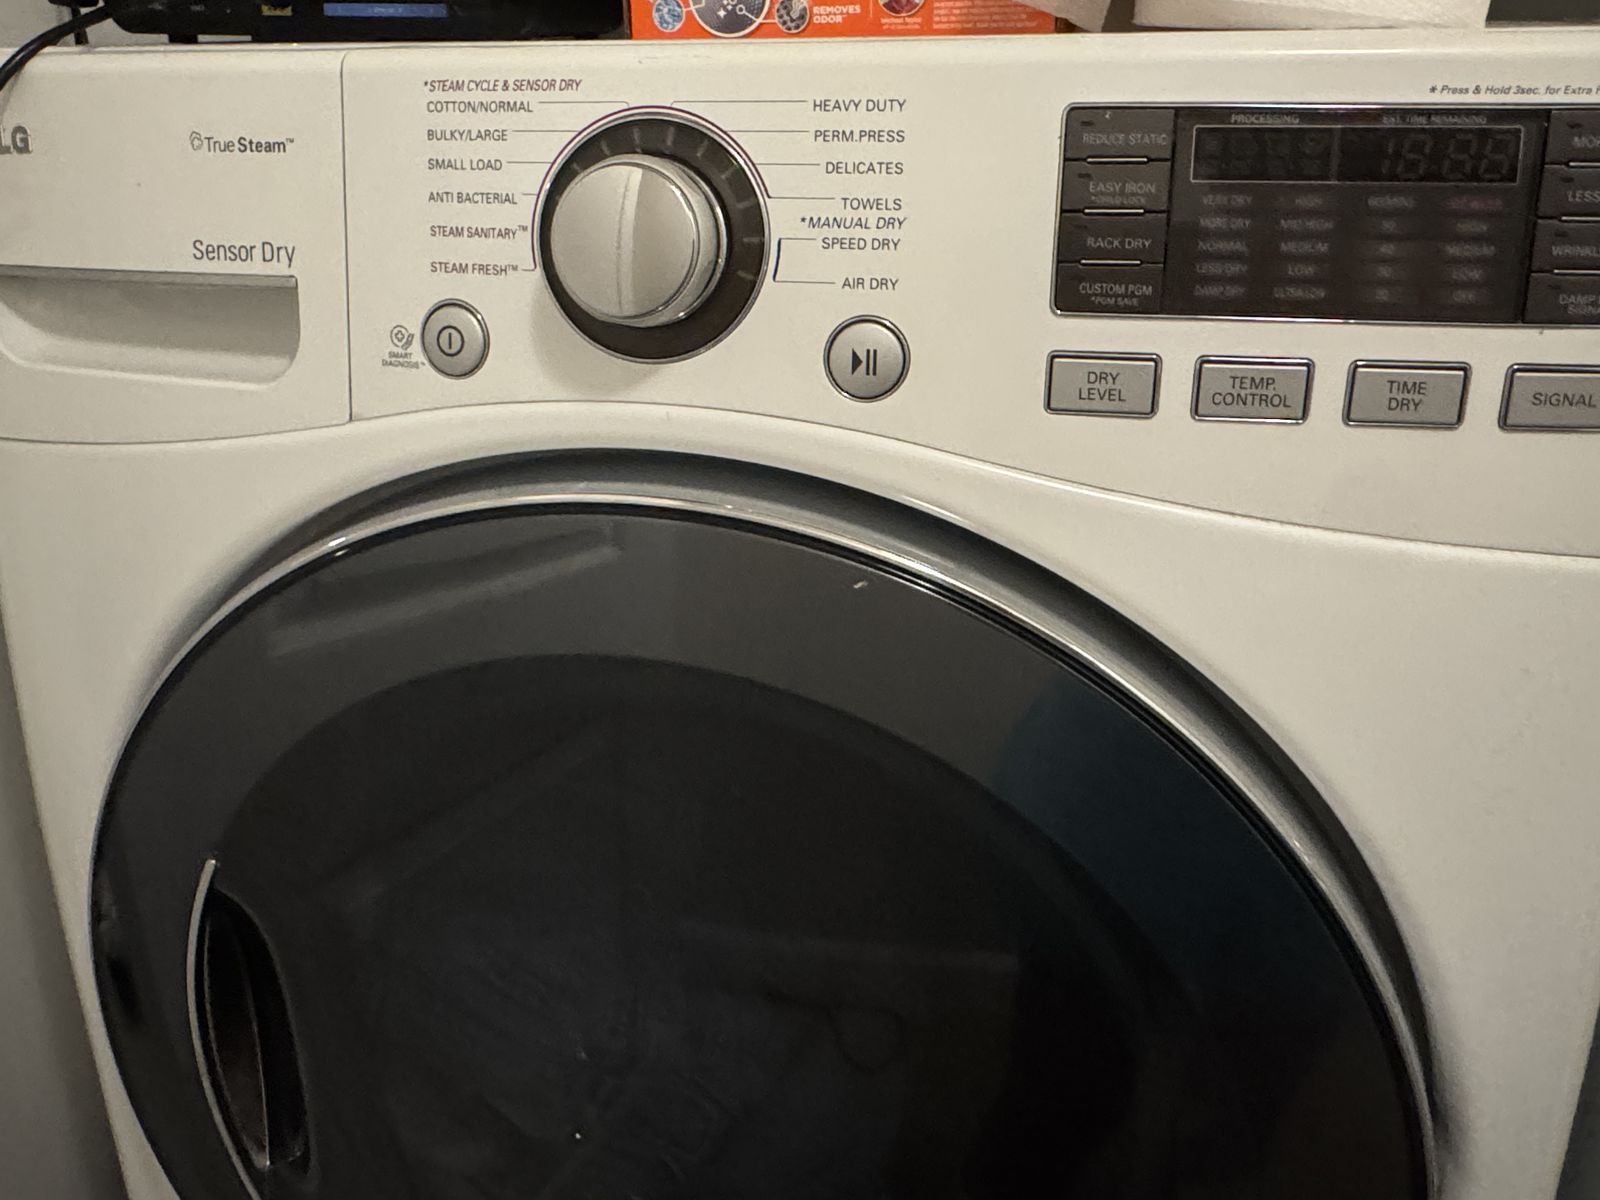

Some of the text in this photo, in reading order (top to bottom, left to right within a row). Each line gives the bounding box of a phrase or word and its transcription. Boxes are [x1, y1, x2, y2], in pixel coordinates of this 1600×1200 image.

[813, 5, 861, 14] REMOVES
[467, 79, 499, 91] CYCLE
[501, 79, 509, 91] &
[512, 79, 556, 91] SENSOR
[558, 79, 582, 91] DRY
[1440, 85, 1469, 95] Press
[1472, 85, 1481, 94] &
[1485, 85, 1512, 95] Hold
[1513, 85, 1540, 95] 3sec.
[1544, 85, 1561, 95] for
[1564, 85, 1593, 95] Extra
[426, 100, 533, 113] COTTON/NORMAL
[813, 99, 906, 112] HEAVY DUTY
[1230, 114, 1300, 124] PROCESSING
[1407, 115, 1429, 124] TIME
[0, 126, 32, 154] LG
[427, 129, 508, 141] BULKY/LARGE
[814, 129, 905, 143] PERM.PRESS
[1082, 133, 1168, 145] REDUCE STATIC
[427, 158, 503, 171] SMALL LOAD
[825, 161, 904, 175] DELICATES
[1089, 181, 1156, 194] EASY IRON
[428, 192, 518, 204] ANTI BACTERIAL
[841, 197, 902, 211] TOWELS
[876, 217, 907, 230] DRY
[430, 225, 464, 238] STEAM
[821, 237, 901, 251] SPEED DRY
[1086, 237, 1152, 249] RACK DRY
[193, 239, 296, 268] Sensor Dry
[1552, 245, 1600, 257] WRINKL
[430, 261, 469, 274] STEAM
[841, 277, 900, 291] AIR DRY
[1079, 282, 1153, 296] CUSTOM PGM
[388, 351, 413, 359] SMART
[1087, 371, 1120, 385] DRY
[1229, 376, 1276, 391] TEMP.
[1387, 380, 1427, 395] TIME
[1078, 388, 1126, 402] LEVEL
[1212, 392, 1291, 408] CONTROL
[1531, 392, 1597, 408] SIGNAL
[1387, 397, 1423, 412] DRY
